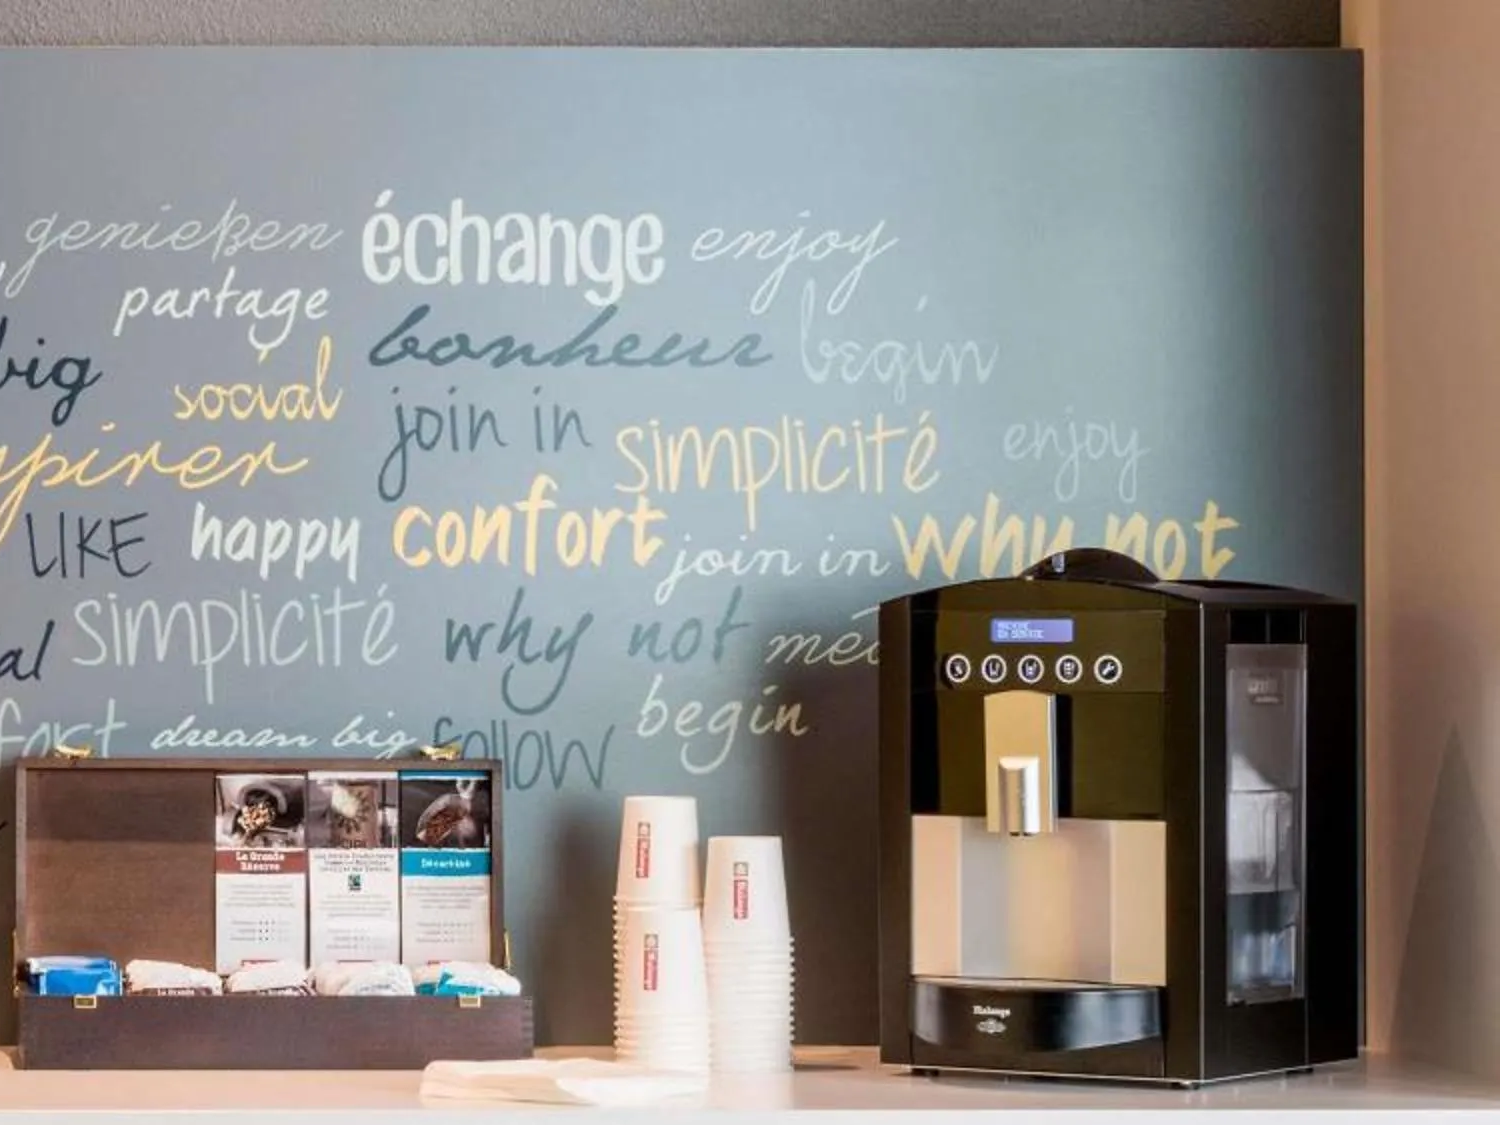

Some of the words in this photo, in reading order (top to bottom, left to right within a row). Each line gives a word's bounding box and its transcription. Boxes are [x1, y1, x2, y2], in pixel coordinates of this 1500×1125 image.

[363, 189, 665, 308] échange
[691, 209, 900, 315] enjoy
[113, 266, 330, 352] partage
[368, 303, 774, 369] bonheur
[799, 278, 1000, 404] begin
[173, 334, 344, 421] social
[377, 385, 510, 502] join
[532, 385, 593, 452] in
[613, 411, 940, 532] simplicité
[1002, 405, 1152, 502] enjoy
[25, 510, 151, 581] LIKE
[190, 500, 361, 584] happy
[393, 473, 668, 576] confort
[653, 534, 803, 605] join
[821, 533, 892, 579] in
[71, 582, 400, 704] simplicité
[444, 586, 594, 717] why
[627, 584, 752, 665] not
[150, 714, 321, 751] dream
[330, 709, 419, 760] big
[637, 673, 810, 776] begin
